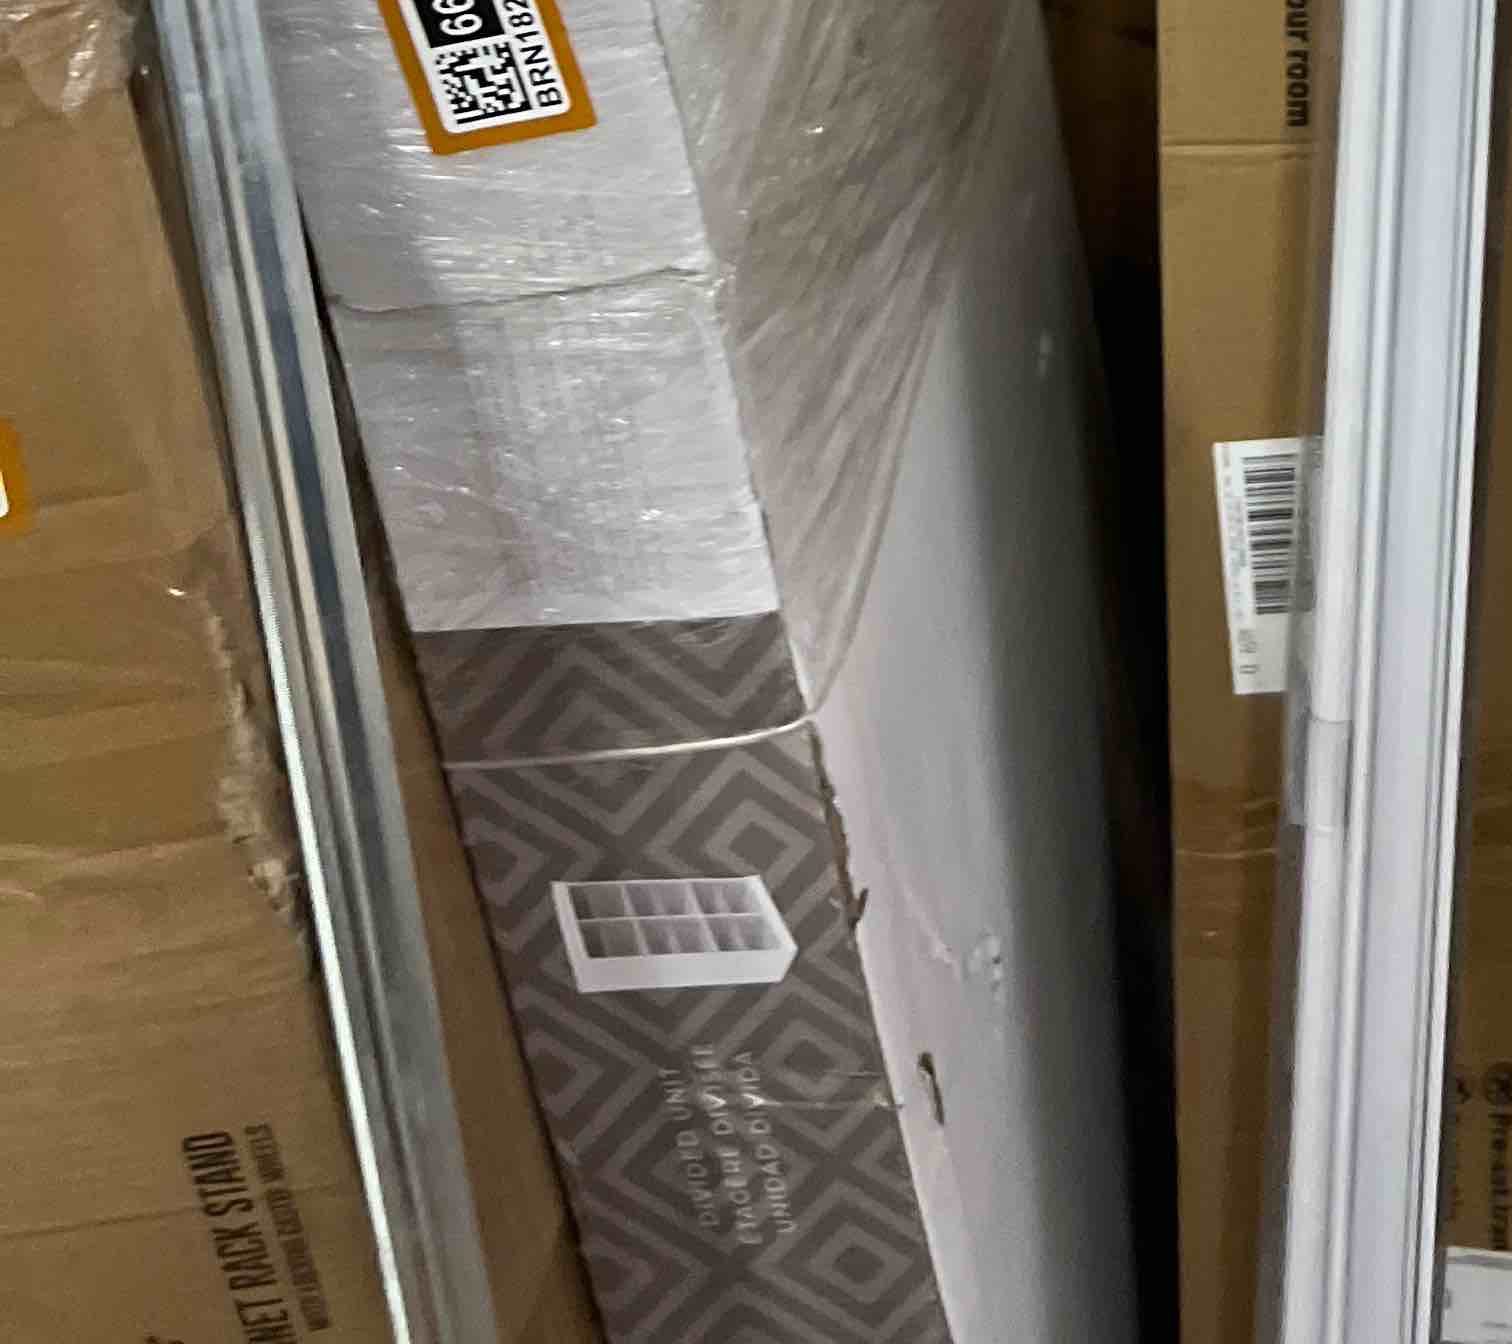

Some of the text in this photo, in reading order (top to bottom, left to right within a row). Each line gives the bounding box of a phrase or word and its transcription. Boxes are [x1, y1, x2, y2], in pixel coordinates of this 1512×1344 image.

[1285, 49, 1311, 127] room
[659, 1068, 690, 1121] UNIT
[182, 1130, 255, 1217] STAND
[212, 1221, 278, 1291] RACK
